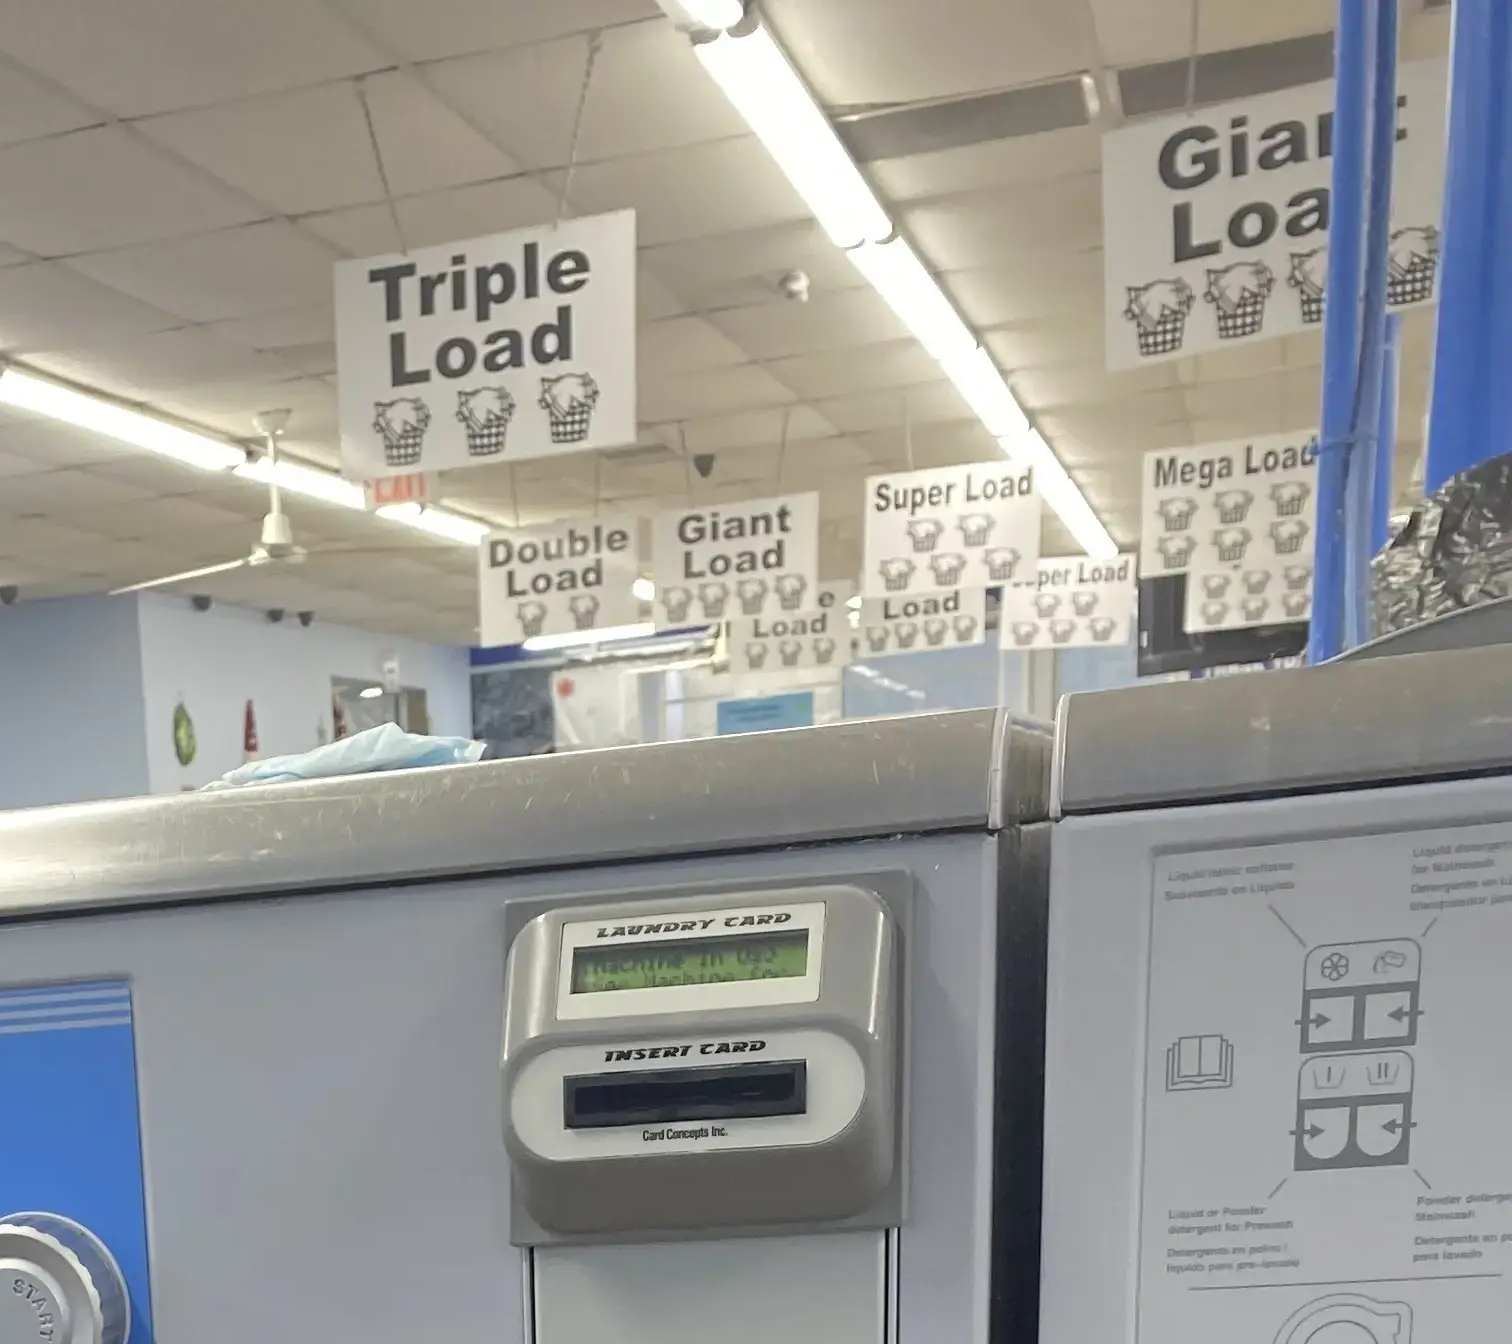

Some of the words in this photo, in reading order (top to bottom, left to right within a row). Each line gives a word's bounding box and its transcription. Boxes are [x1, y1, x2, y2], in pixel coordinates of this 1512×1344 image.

[1158, 95, 1407, 190] Gia
[1172, 187, 1331, 263] Loa
[369, 241, 591, 323] Triple
[390, 306, 574, 388] Load
[874, 479, 957, 515] Super
[965, 466, 1035, 502] Load
[1154, 456, 1233, 489] Mega
[676, 504, 792, 546] Giant
[488, 525, 630, 570] Double
[684, 539, 786, 580] Load
[505, 557, 604, 598] Load
[1012, 567, 1071, 591] per
[1078, 559, 1128, 584] Load
[753, 612, 828, 638] Load
[884, 590, 960, 620] Load
[597, 918, 716, 938] LAUNDRY
[724, 912, 792, 928] CARD
[605, 1045, 692, 1062] INSERT
[700, 1040, 767, 1056] CARD
[642, 1129, 665, 1141] Card
[667, 1126, 709, 1140] Concepts
[711, 1126, 729, 1137] Inc.
[13, 1278, 55, 1344] START
